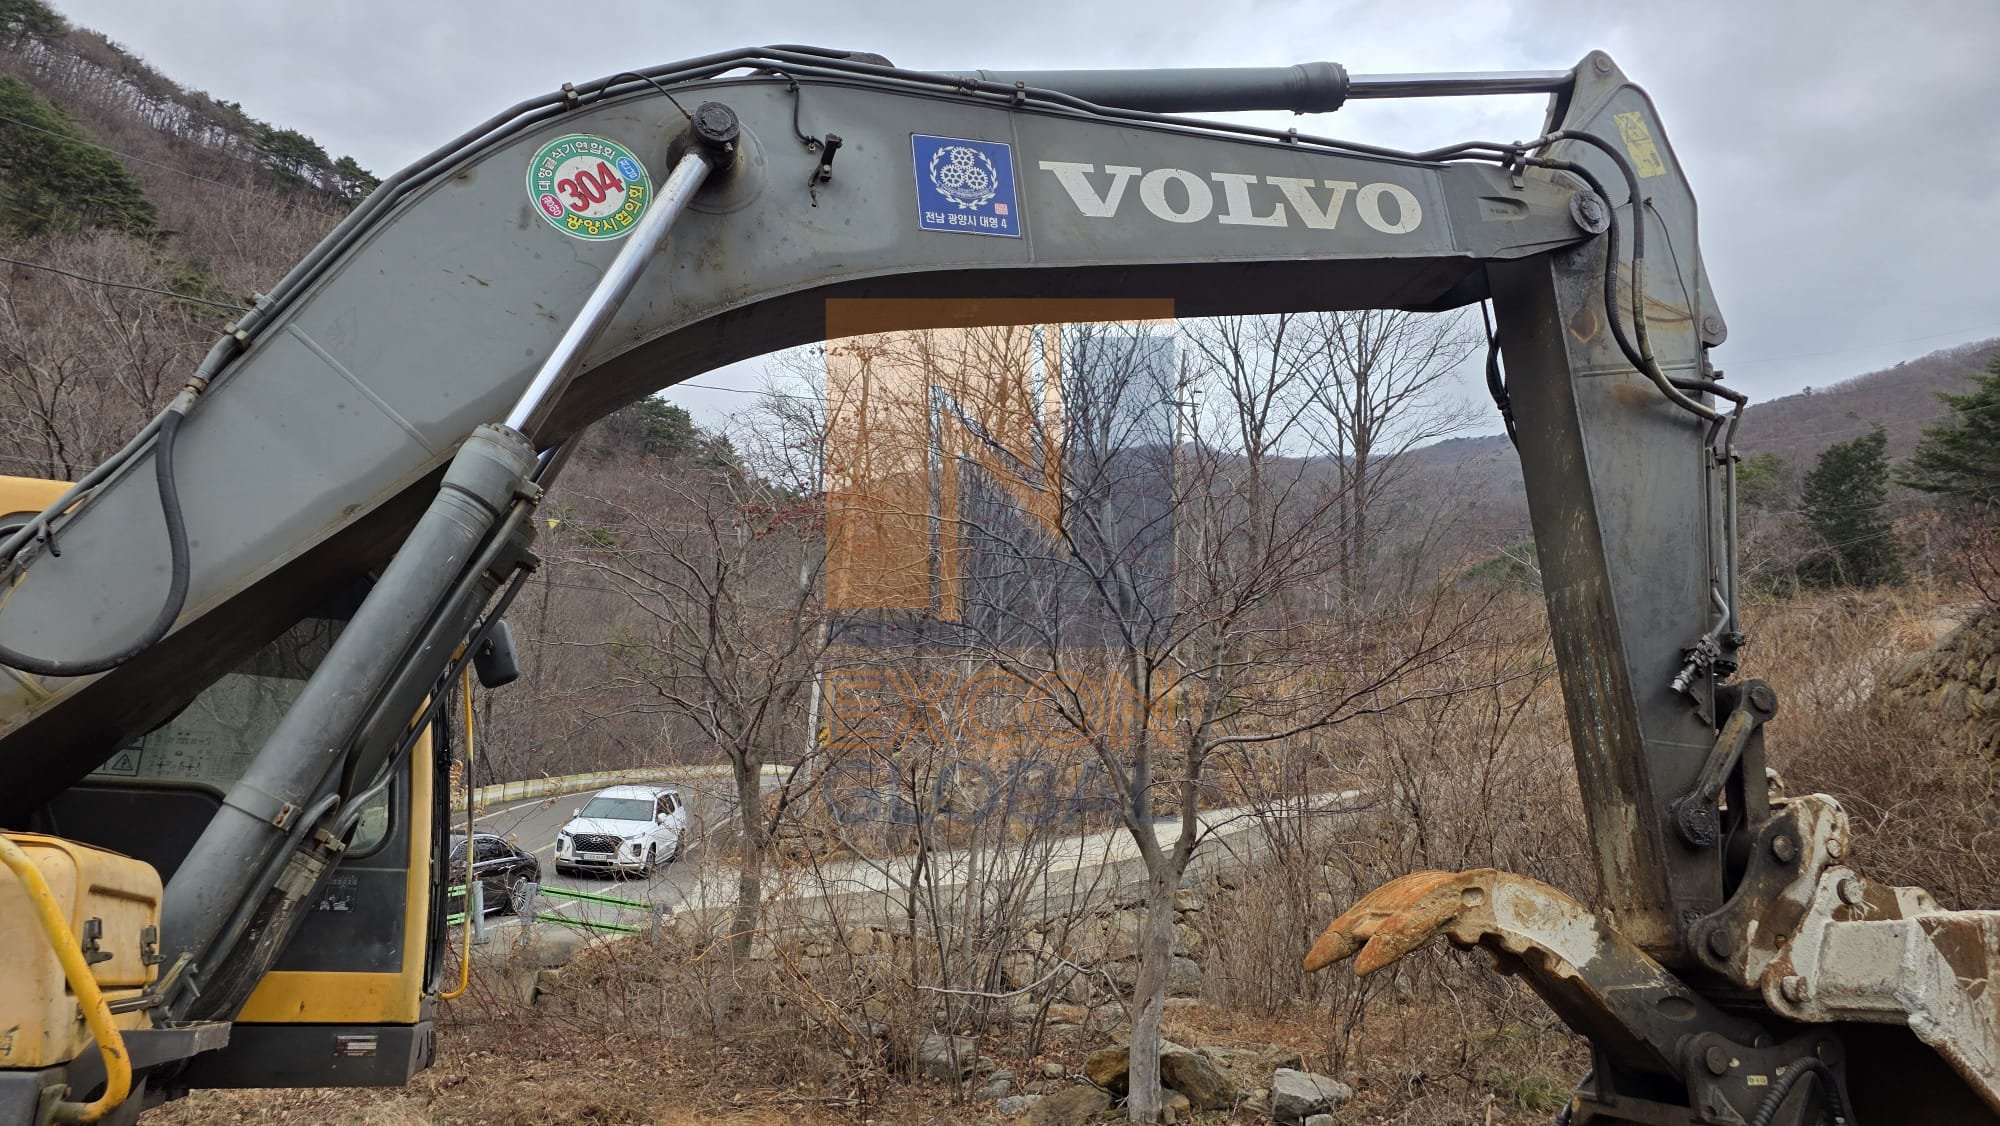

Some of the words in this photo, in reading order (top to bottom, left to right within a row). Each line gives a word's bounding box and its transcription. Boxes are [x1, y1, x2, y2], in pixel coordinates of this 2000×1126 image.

[557, 161, 625, 212] 304
[1038, 160, 1423, 235] VOLVO
[925, 211, 945, 224] 전남
[948, 213, 977, 227] 광양시
[980, 216, 998, 228] 대형
[1001, 218, 1008, 229] 4
